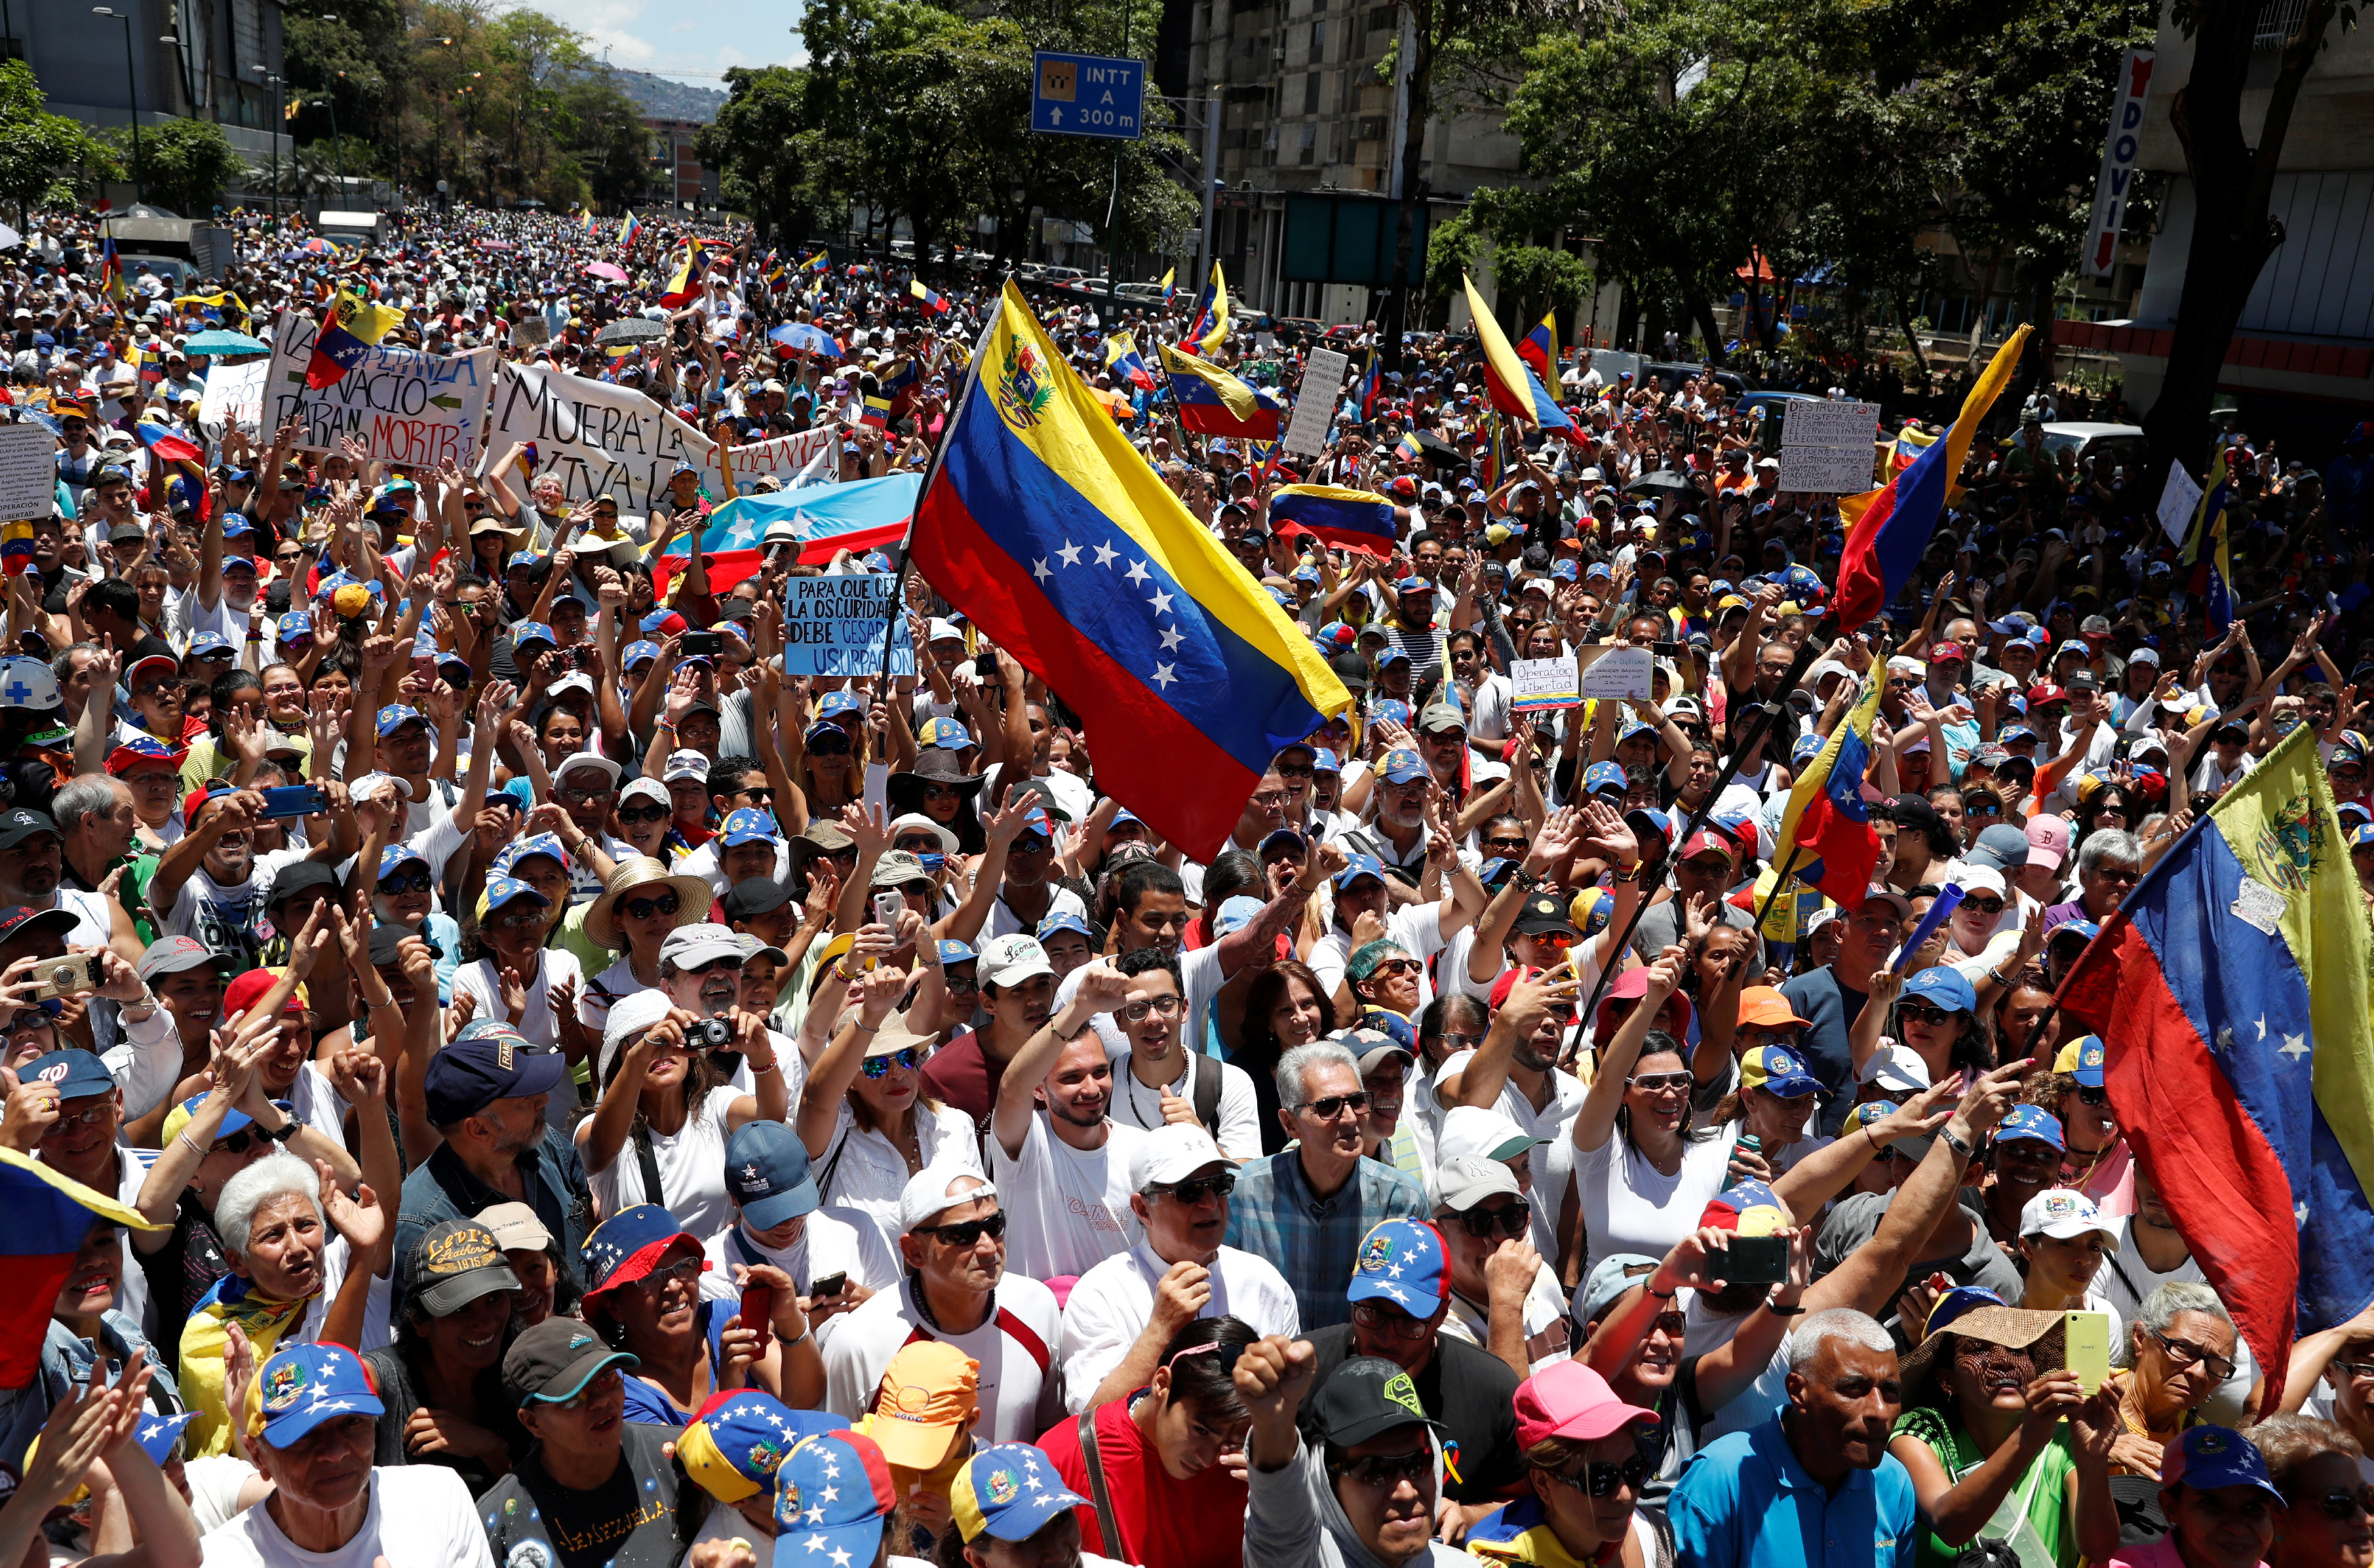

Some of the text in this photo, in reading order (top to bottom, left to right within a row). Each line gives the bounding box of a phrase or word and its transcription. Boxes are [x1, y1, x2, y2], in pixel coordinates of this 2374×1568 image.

[1087, 67, 1131, 85] INTT
[1100, 90, 1114, 105] A
[1080, 109, 1133, 128] 300 m
[2105, 102, 2141, 228] DOVI
[1309, 360, 1344, 374] COMUNIDAD
[1314, 353, 1341, 364] GRACIAS
[1802, 420, 1846, 429] SUMINISTRO
[656, 408, 694, 465] LA
[1804, 448, 1836, 457] FUENTES
[1, 511, 35, 520] LIBERTAD
[798, 576, 899, 599] PARA QUE CES
[787, 600, 808, 619] LA
[790, 621, 834, 644] DEBE
[1517, 662, 1574, 682] Operación
[2041, 830, 2052, 844] B
[1005, 941, 1036, 963] Leones
[570, 1337, 593, 1349] adidas
